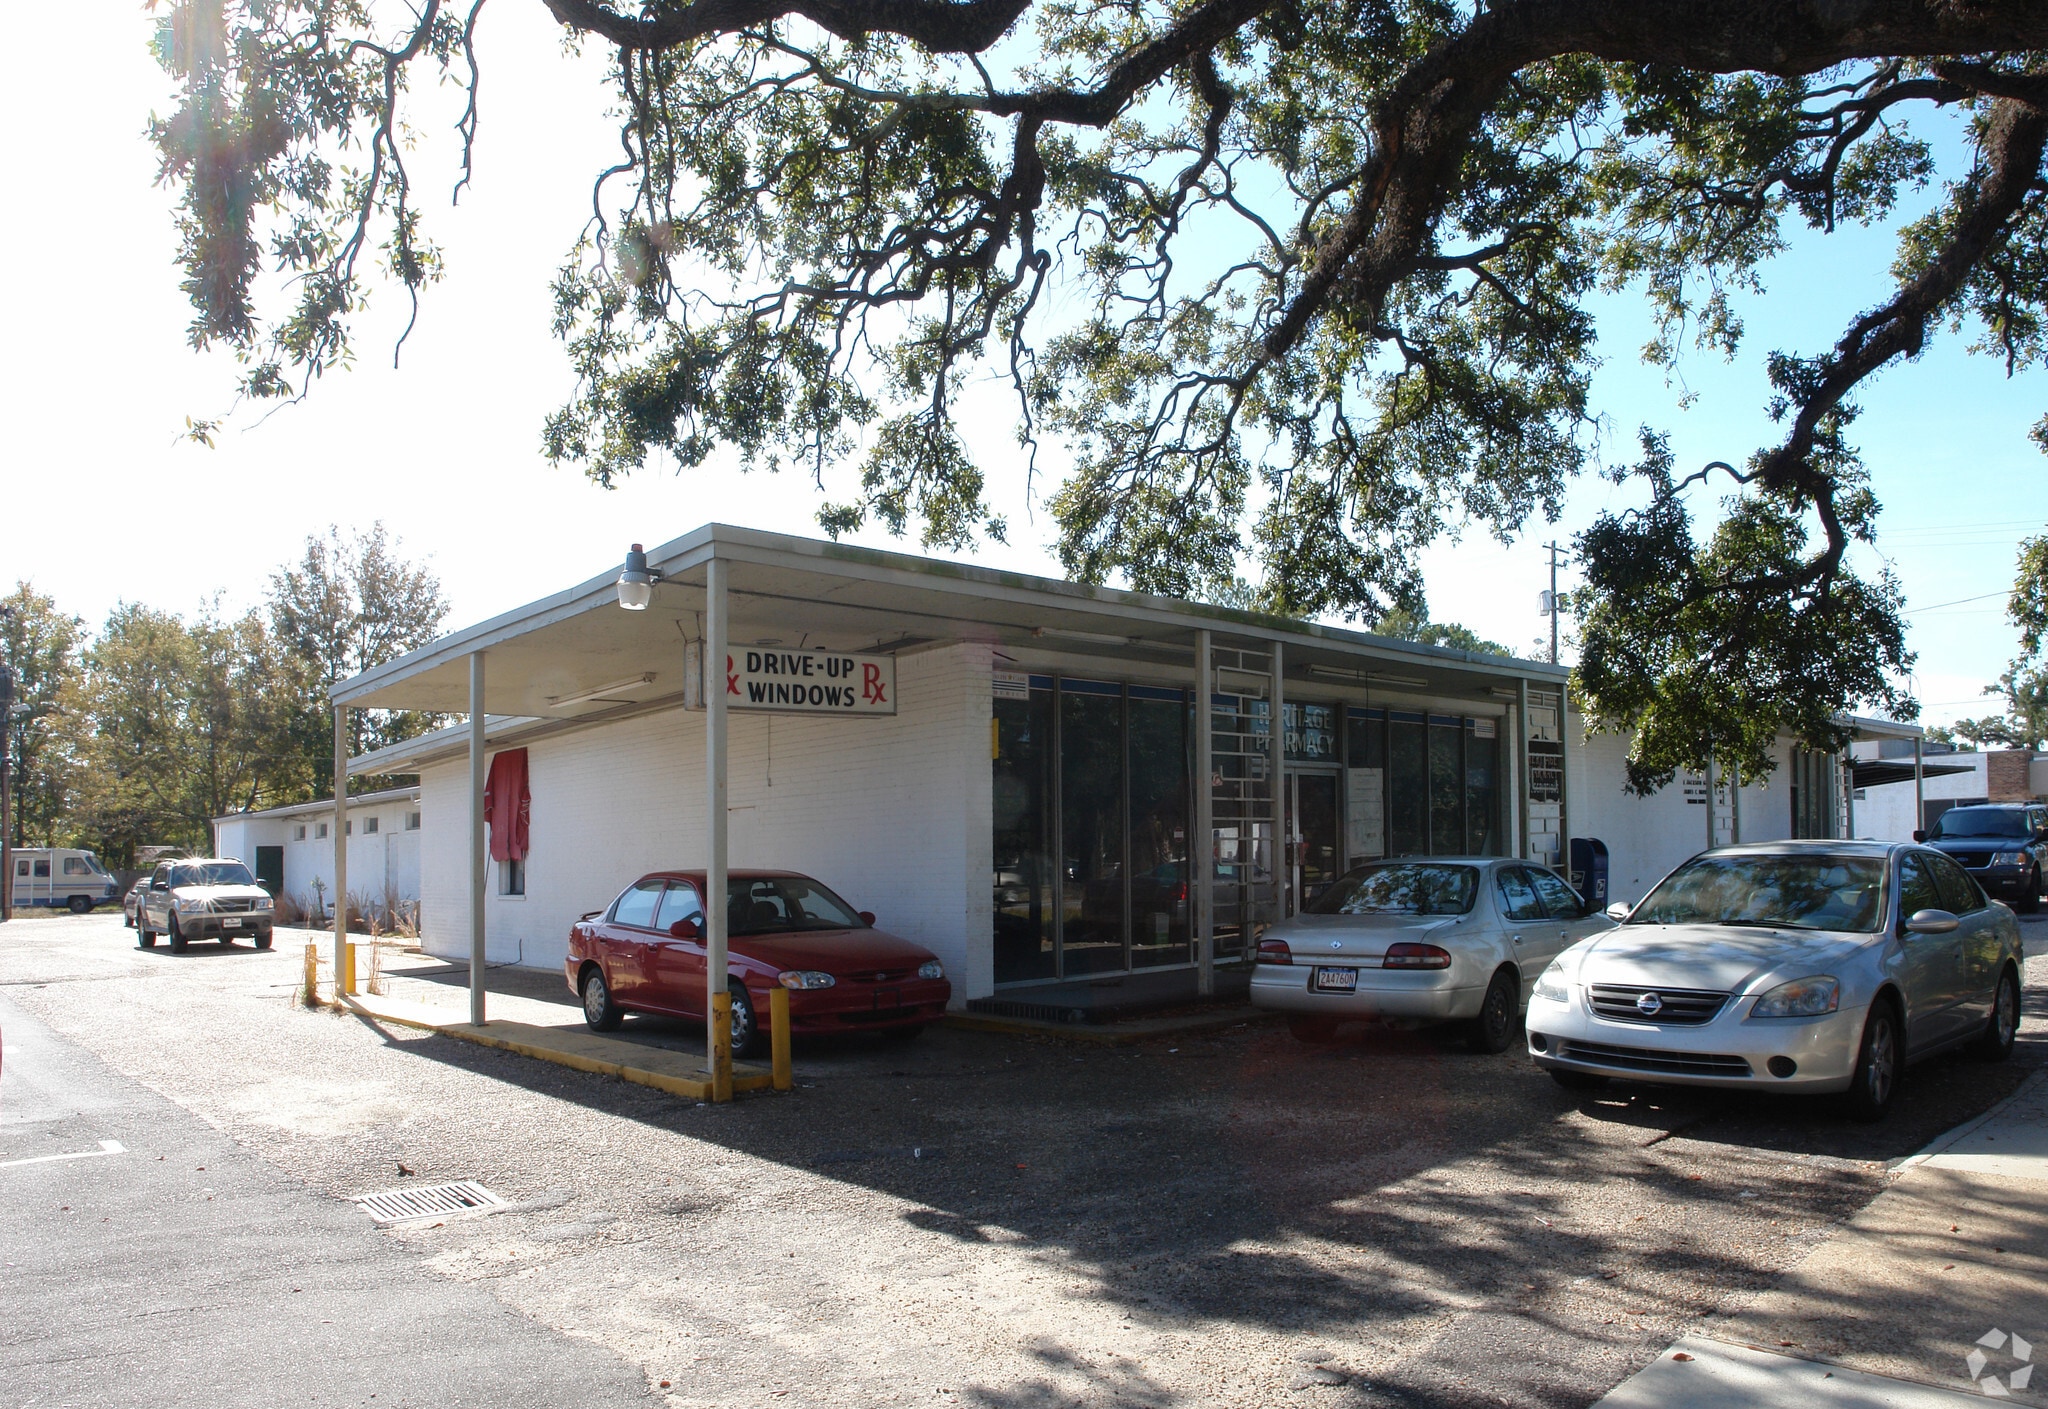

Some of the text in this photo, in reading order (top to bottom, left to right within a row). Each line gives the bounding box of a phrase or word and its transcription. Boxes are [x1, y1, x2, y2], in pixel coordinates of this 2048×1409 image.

[747, 652, 854, 678] DRIVE-UP
[747, 682, 855, 707] WINDOWS
[1259, 704, 1331, 729] HRITAGE
[1255, 729, 1335, 754] PRMACY
